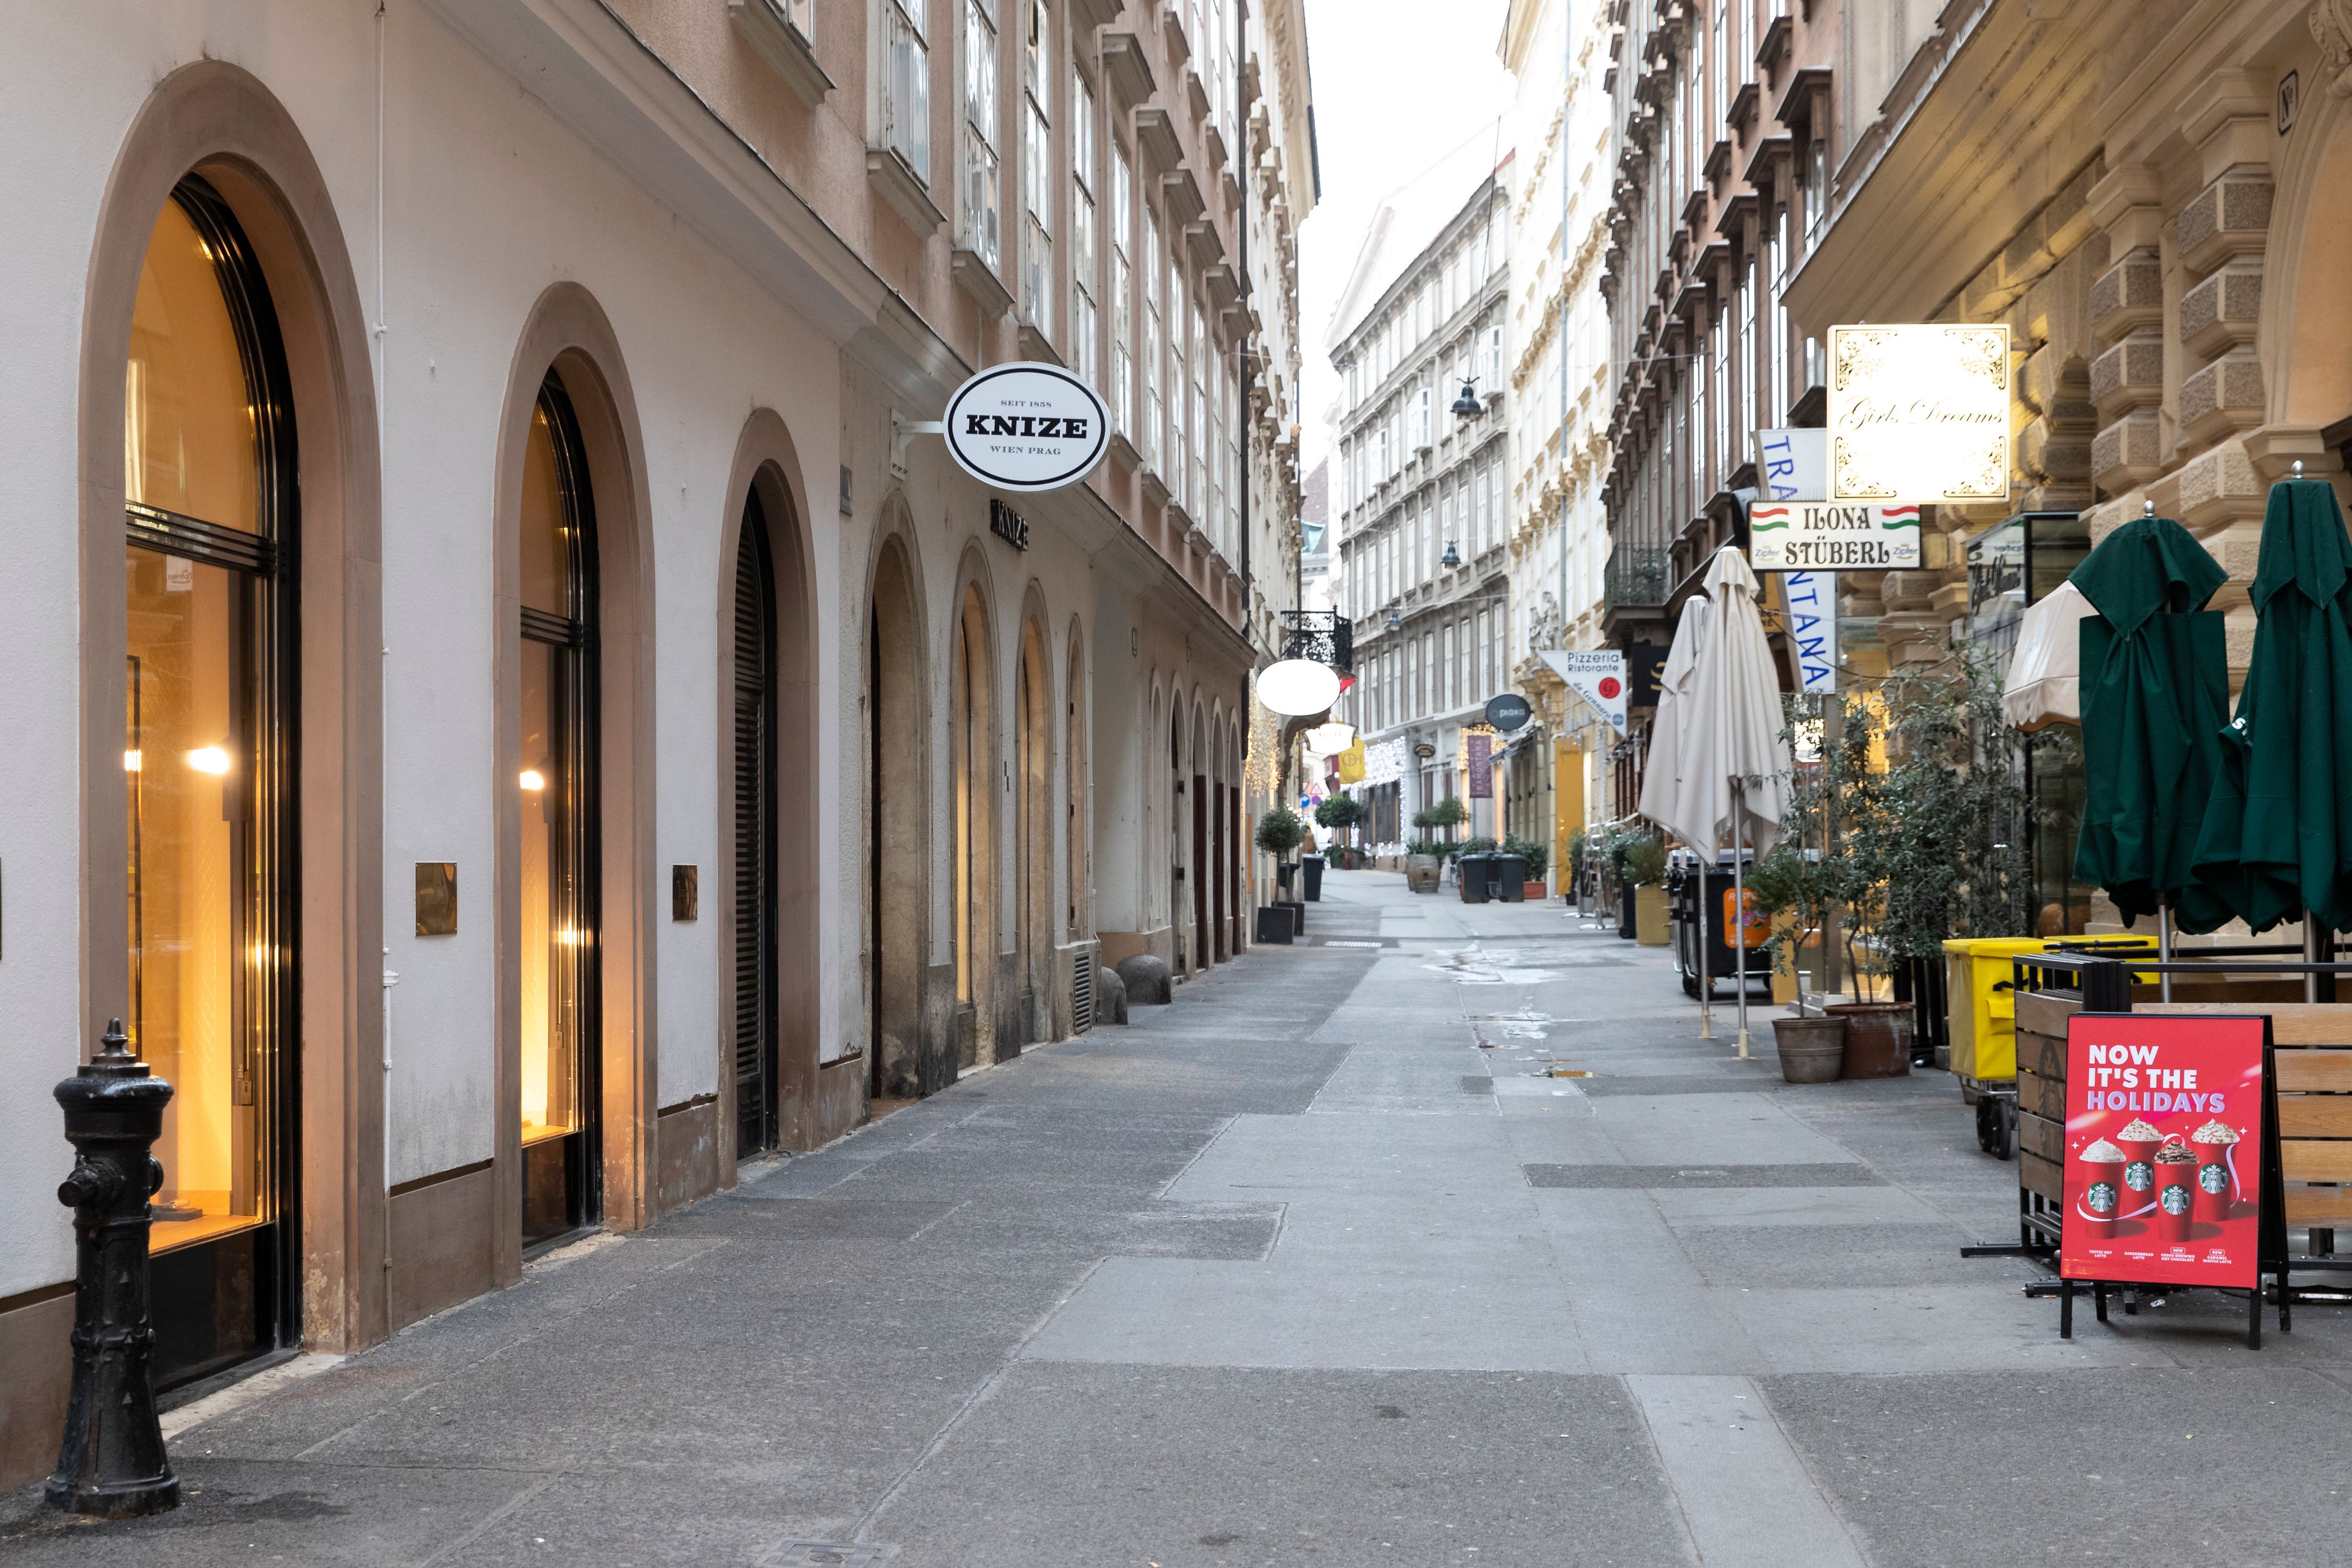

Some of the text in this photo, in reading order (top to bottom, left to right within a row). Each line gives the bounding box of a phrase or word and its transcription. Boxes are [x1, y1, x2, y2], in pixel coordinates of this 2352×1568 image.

[1908, 398, 2003, 424] Dreams
[965, 414, 1088, 439] KNIZE
[990, 446, 1061, 456] WIEN PRAG
[1803, 507, 1872, 530] ILONA
[1786, 535, 1890, 564] STÜBERL
[1568, 652, 1619, 663] Pizzeria
[1568, 664, 1619, 672] Ristorante
[1573, 682, 1611, 719] da Gennaro
[2089, 1044, 2159, 1065] NOW
[2088, 1068, 2197, 1089] IT'S THE
[2087, 1091, 2226, 1114] HOLIDAYS
